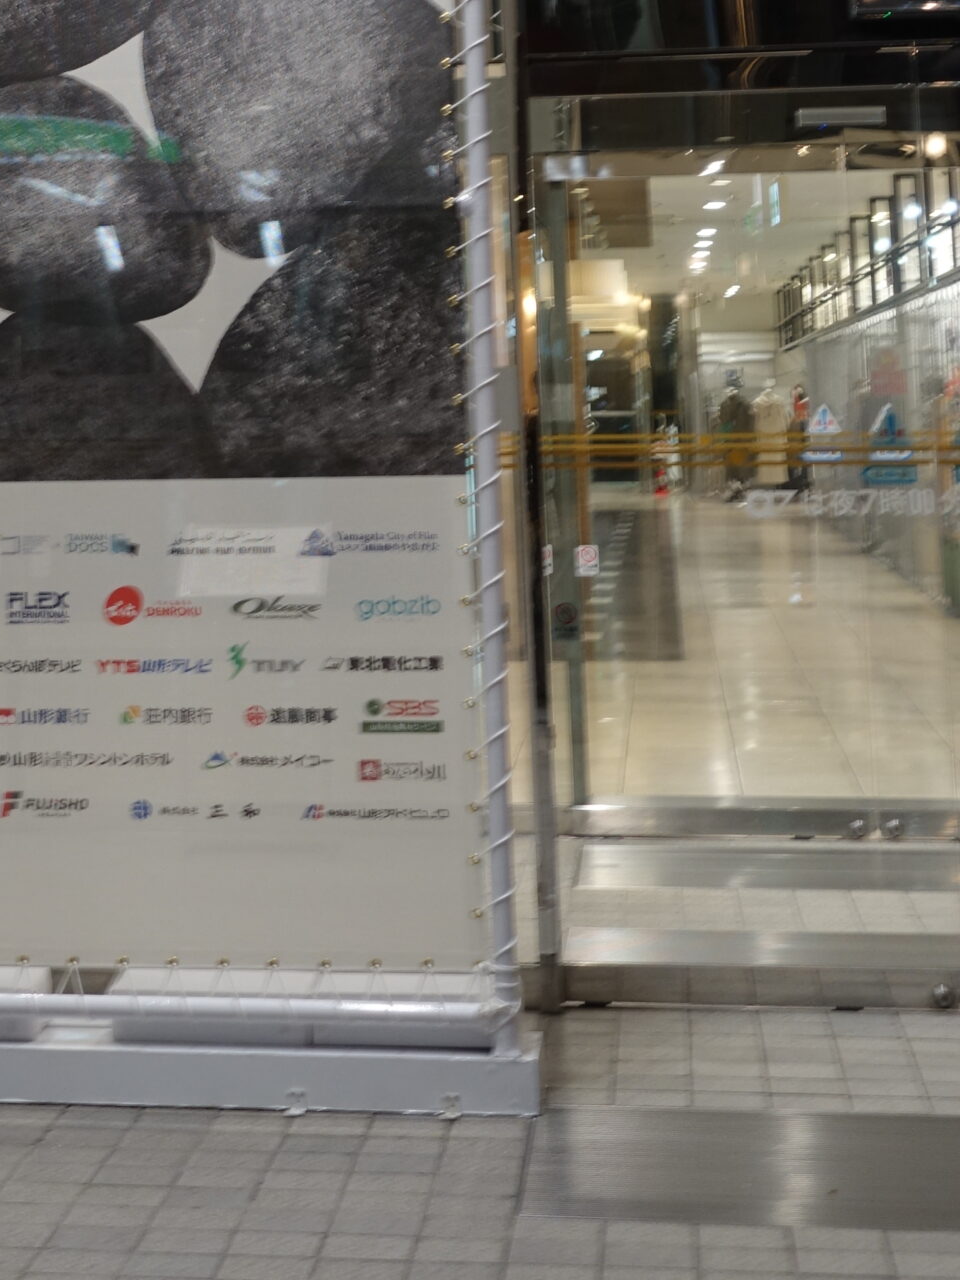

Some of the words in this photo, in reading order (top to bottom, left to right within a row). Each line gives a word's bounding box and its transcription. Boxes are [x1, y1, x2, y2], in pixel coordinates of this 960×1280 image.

[7, 591, 70, 609] FLEX
[20, 708, 90, 725] 山形銀行
